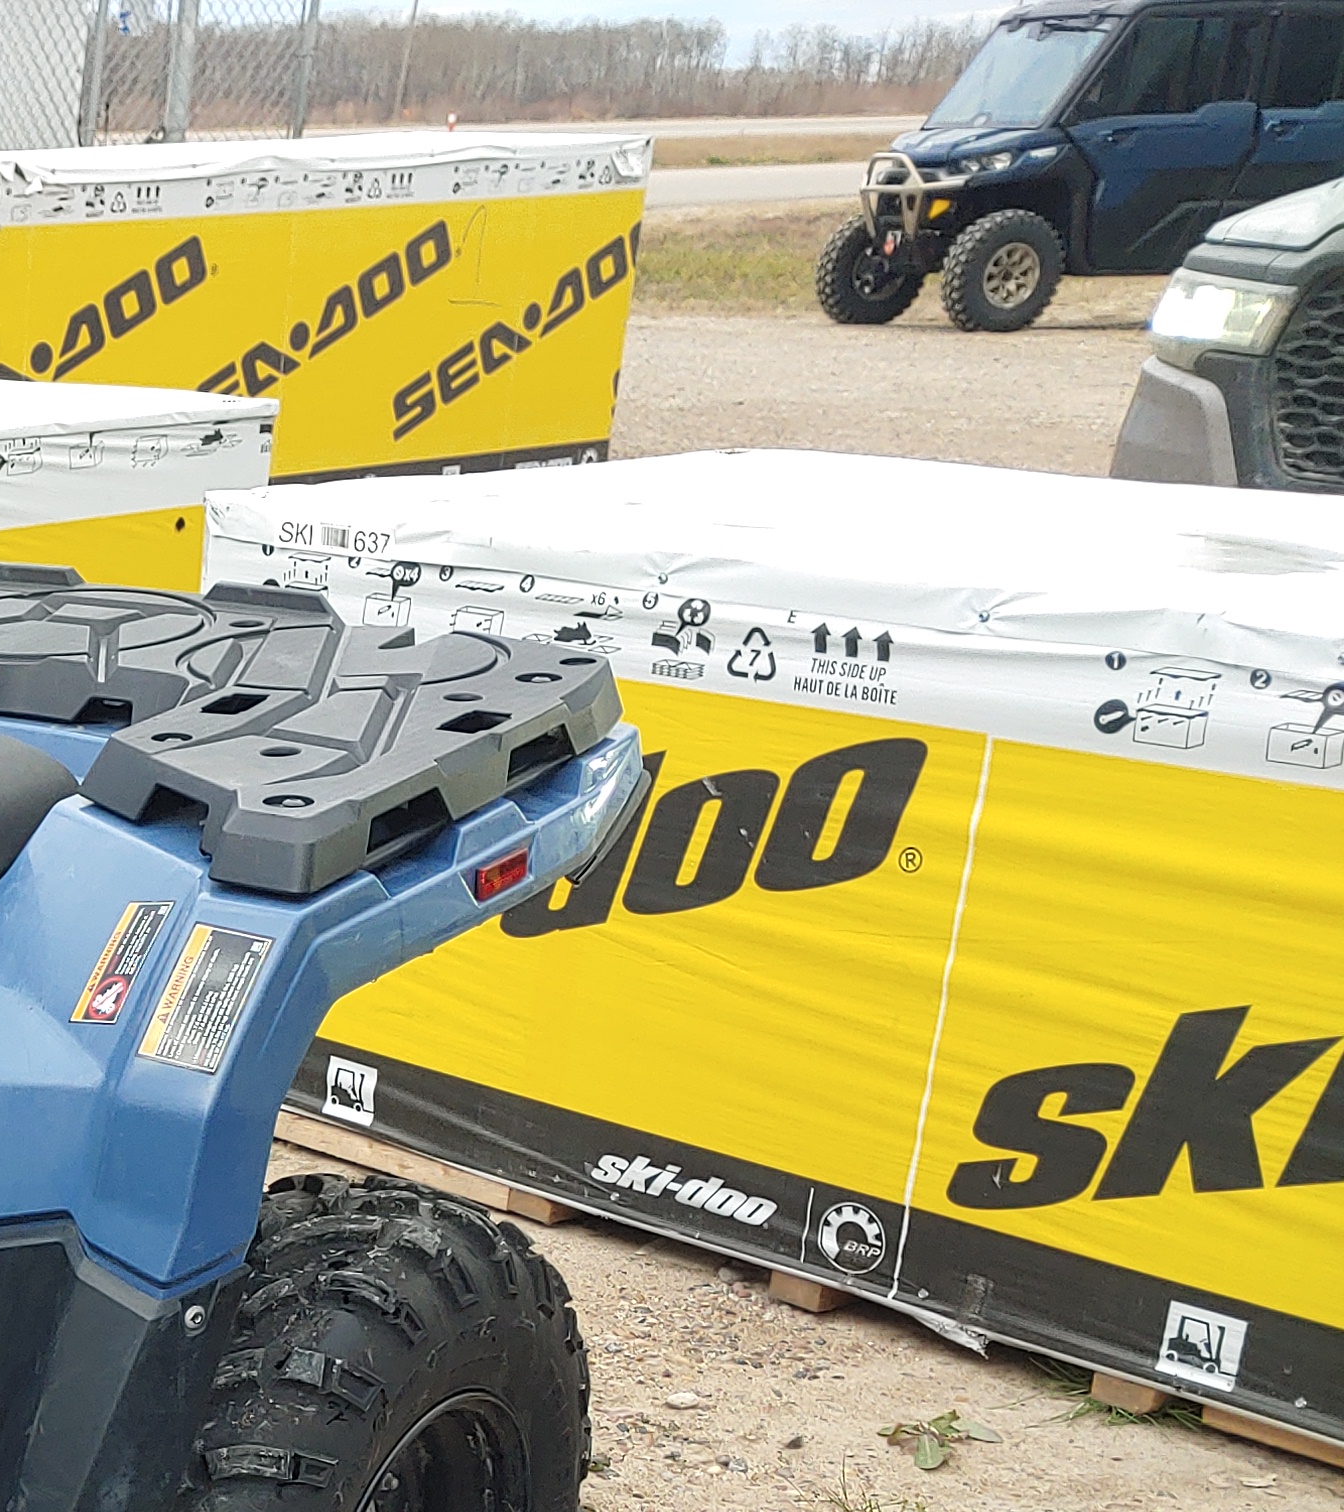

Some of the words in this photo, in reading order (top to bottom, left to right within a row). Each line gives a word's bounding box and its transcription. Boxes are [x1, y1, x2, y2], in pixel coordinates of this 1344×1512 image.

[278, 521, 313, 546] SKI
[354, 530, 392, 554] 637
[811, 657, 837, 676] THIS
[839, 662, 868, 680] SIDE
[869, 666, 887, 682] UP
[794, 676, 824, 696] HAUT
[826, 680, 841, 697] DE
[844, 684, 858, 700] LA
[161, 955, 194, 1011] WARNING
[590, 1154, 779, 1226] ski-doo
[843, 1240, 882, 1259] BRP
